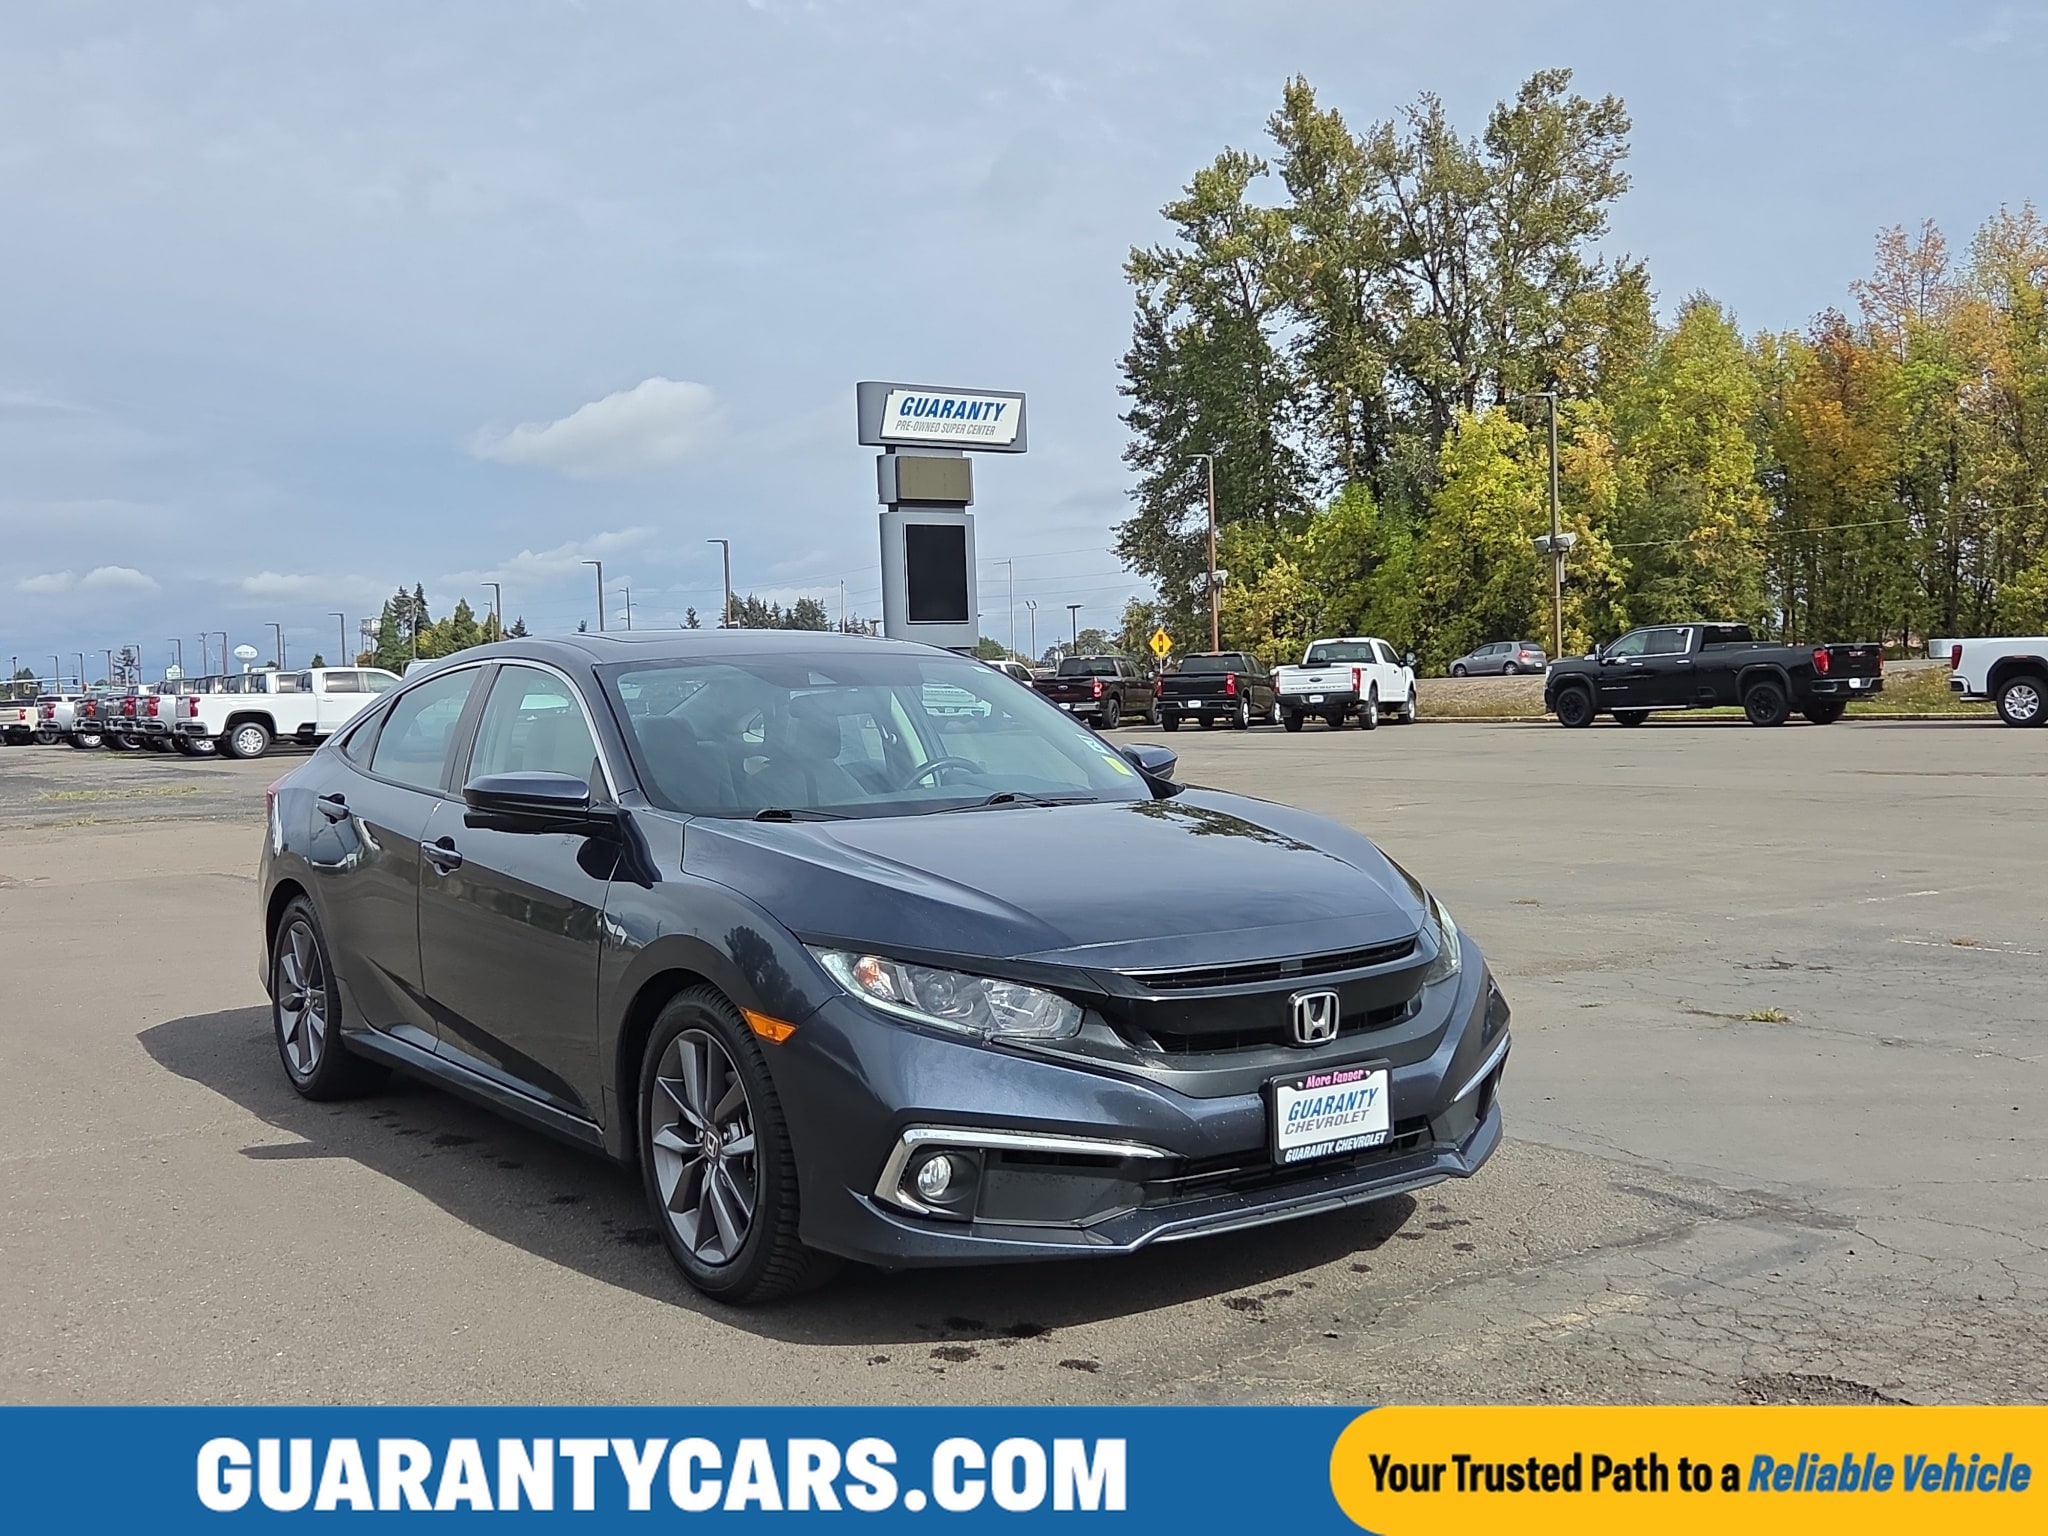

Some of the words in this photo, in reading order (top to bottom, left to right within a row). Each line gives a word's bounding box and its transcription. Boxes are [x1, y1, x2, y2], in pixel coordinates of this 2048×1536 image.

[900, 396, 1007, 422] GUARANTY
[895, 420, 940, 434] PRE-OWNED
[941, 422, 966, 435] SUPER
[966, 424, 996, 436] CENTER
[1306, 1074, 1332, 1089] More
[1288, 1087, 1379, 1122] GUARANTY
[1284, 1109, 1370, 1135] CHEVROLET
[1335, 1131, 1388, 1153] CHEVROLET
